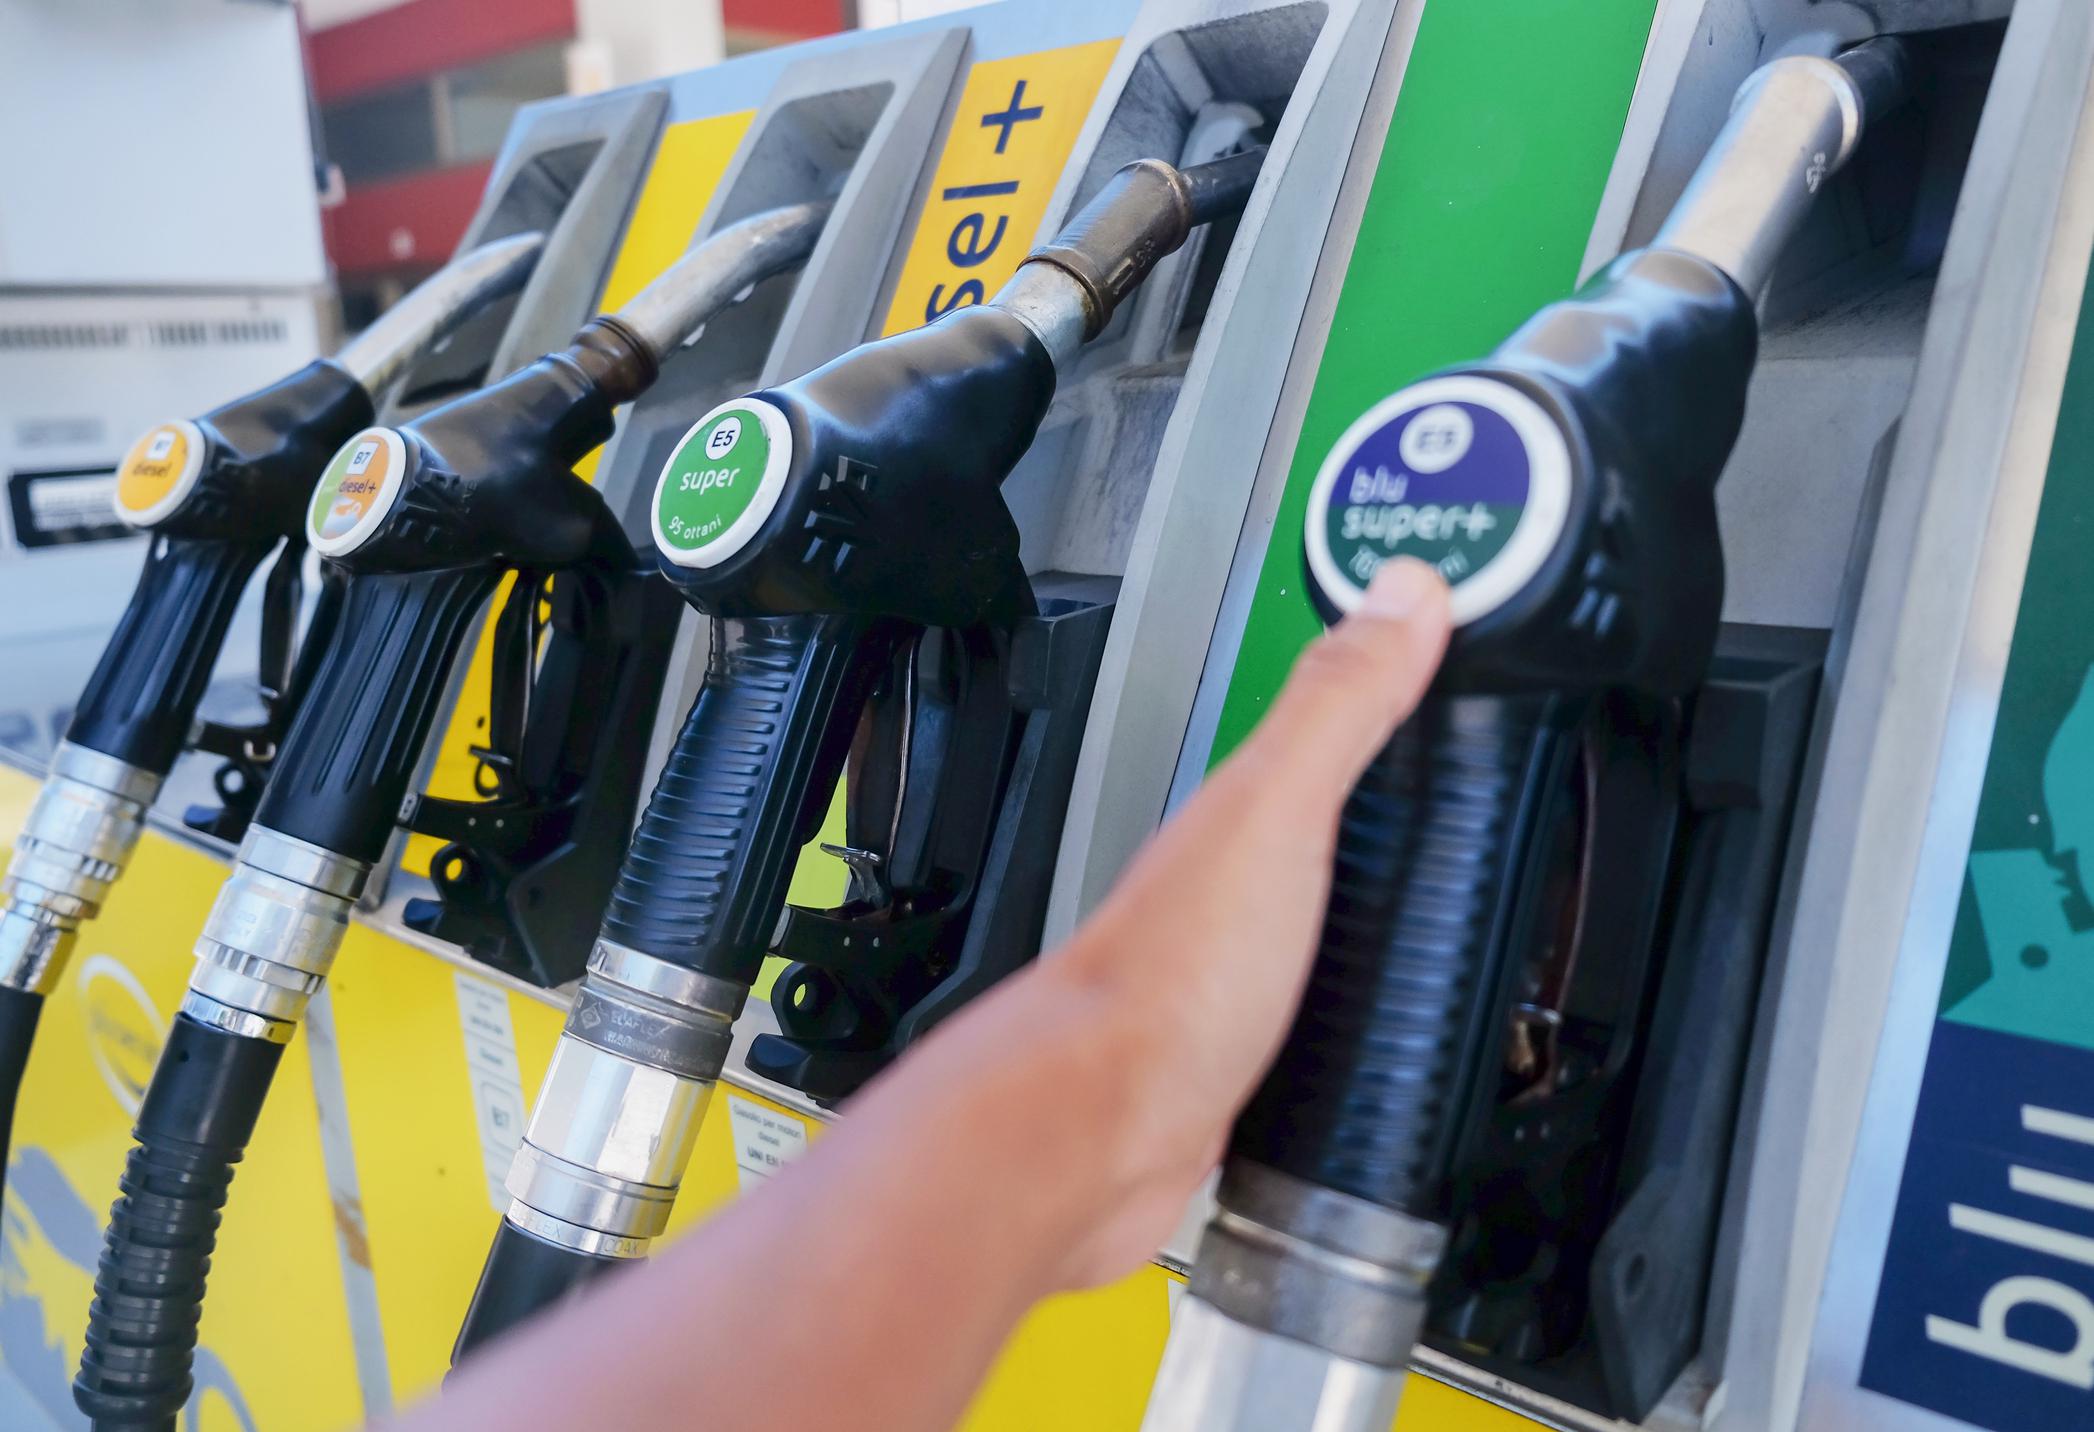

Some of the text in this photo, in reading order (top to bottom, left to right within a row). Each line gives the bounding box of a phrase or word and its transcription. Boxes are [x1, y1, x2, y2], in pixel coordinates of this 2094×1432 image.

[711, 429, 736, 448] E5
[132, 461, 173, 478] diesel
[352, 450, 372, 465] B7
[679, 467, 741, 495] super
[1349, 464, 1409, 504] blu
[668, 513, 723, 540] 95 ottani
[1341, 501, 1498, 550] super+
[1925, 1104, 2094, 1391] blu
